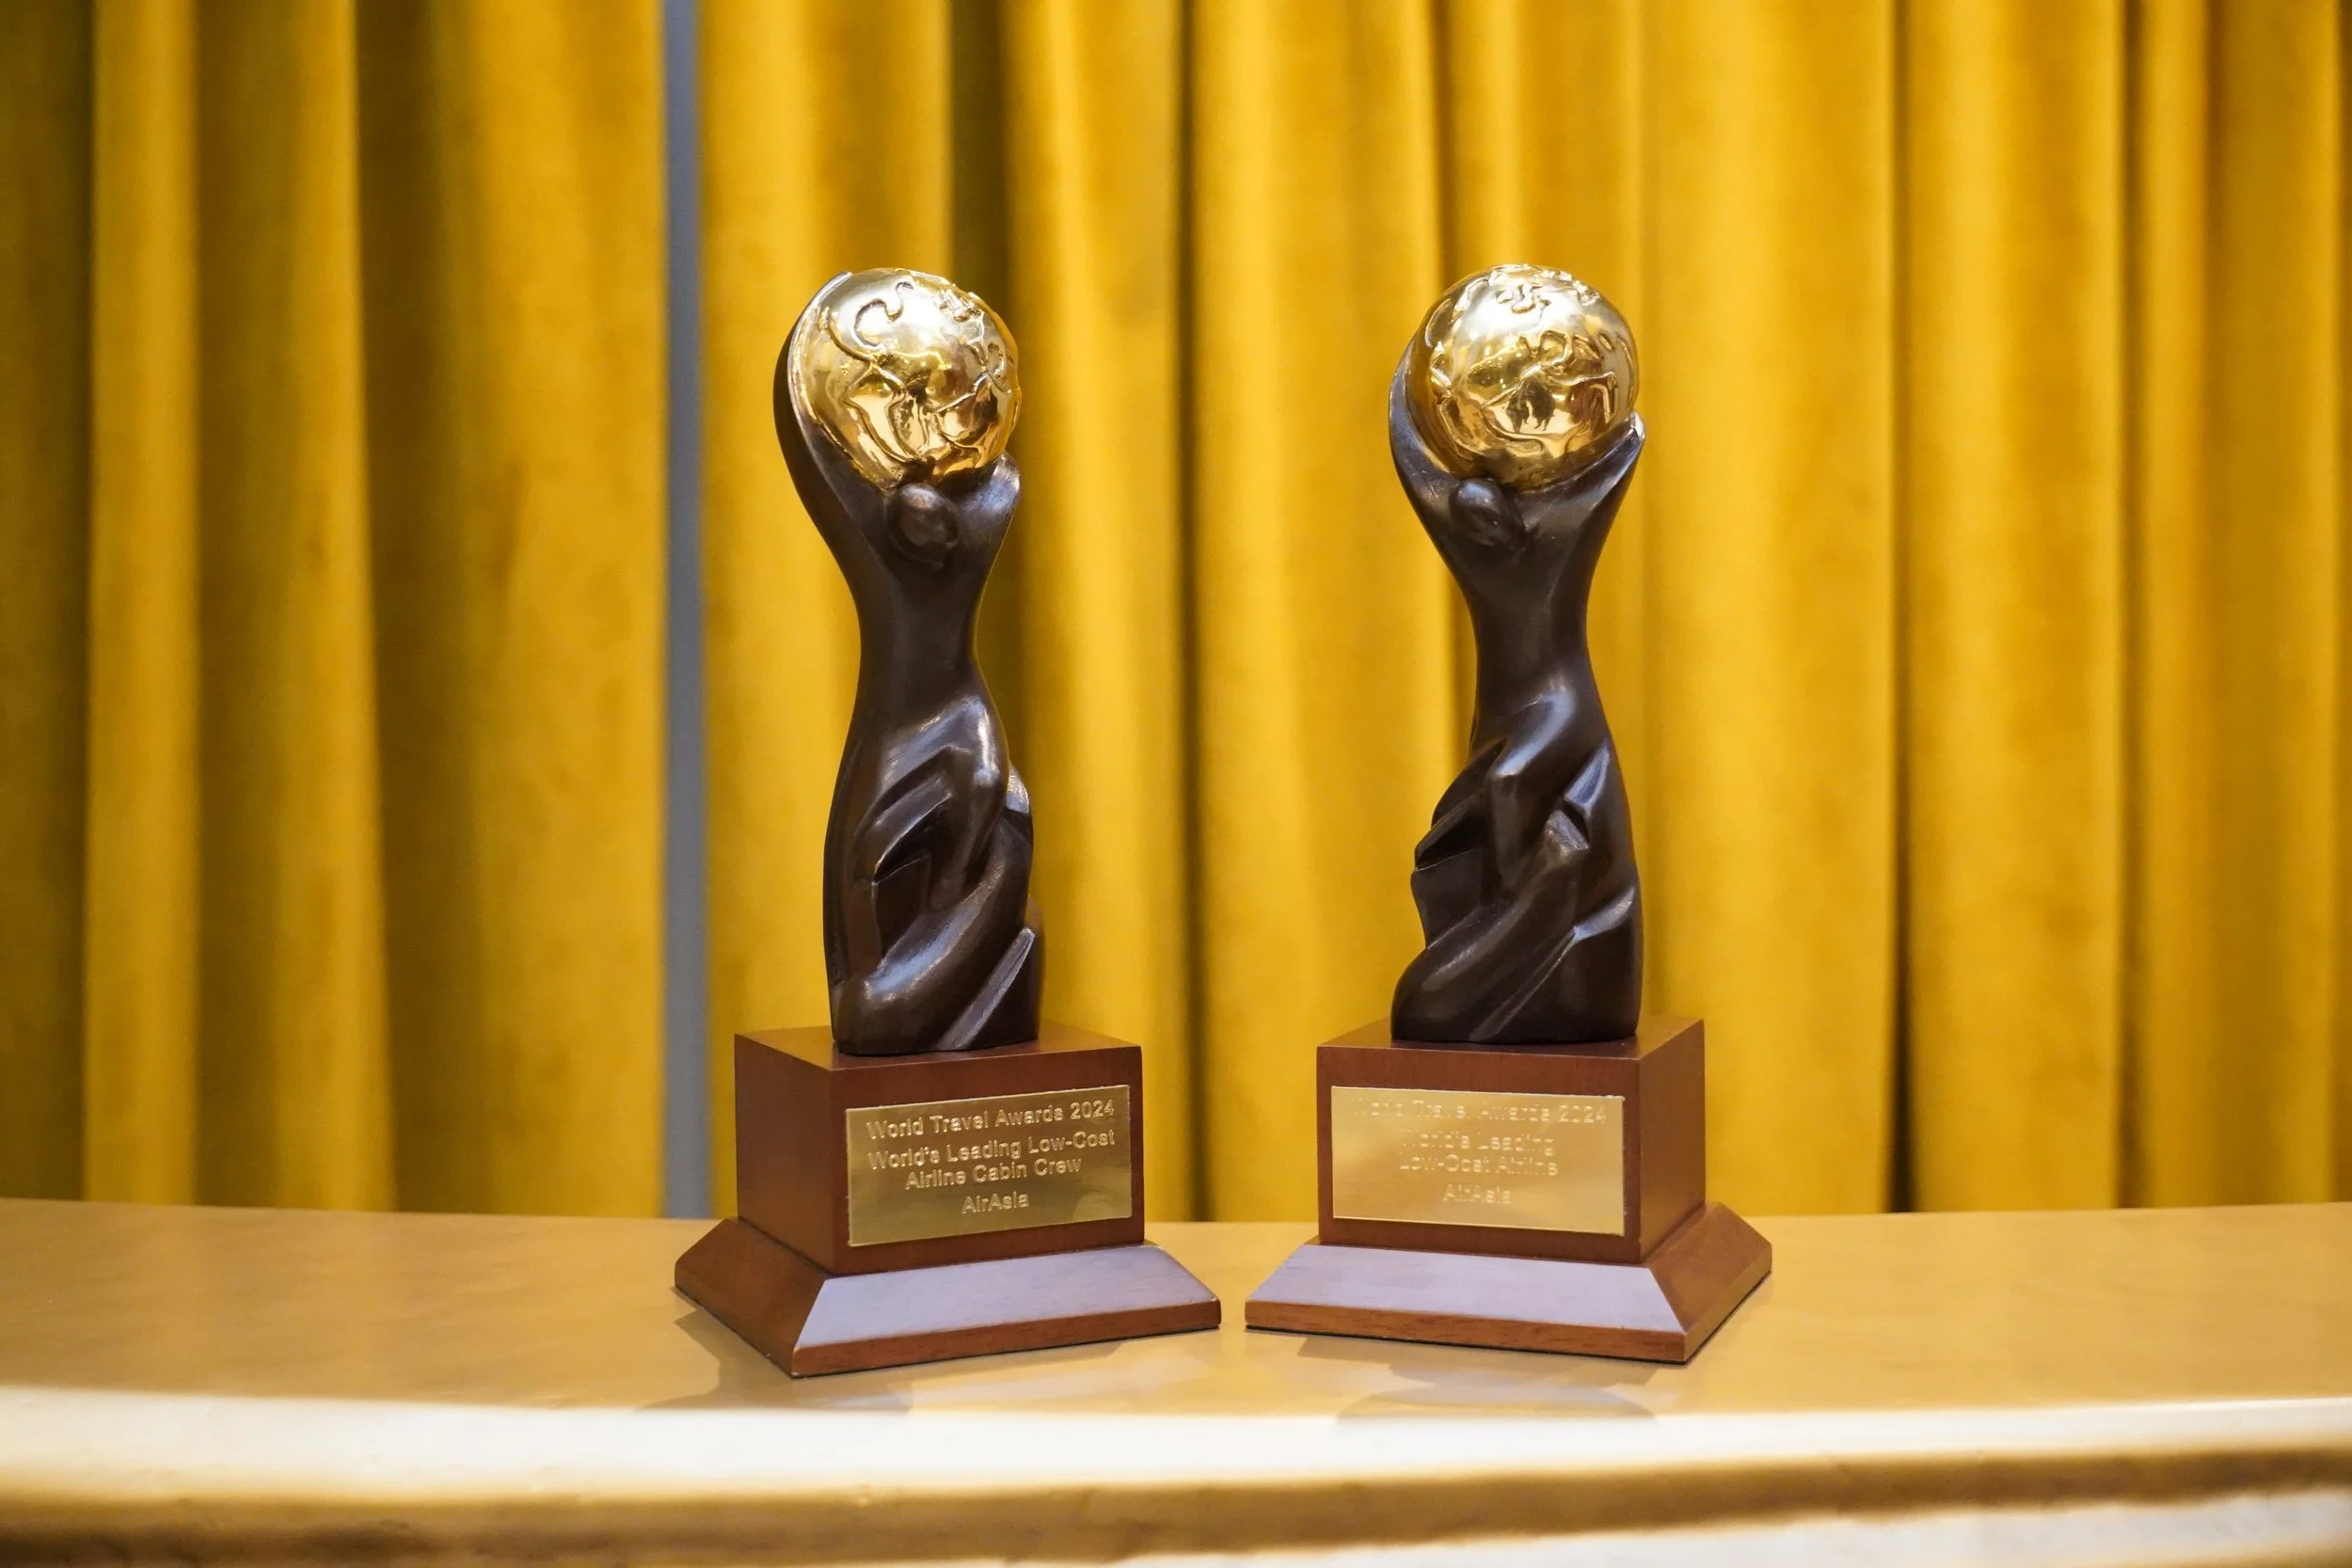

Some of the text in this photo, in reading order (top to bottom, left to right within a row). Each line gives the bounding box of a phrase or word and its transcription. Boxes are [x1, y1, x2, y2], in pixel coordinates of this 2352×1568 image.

[866, 1099, 1115, 1140] World Travel Awards 2024
[868, 1129, 1116, 1170] World's Leading Low-Cost
[905, 1157, 1082, 1191] Airline Cabin Crew
[961, 1191, 1029, 1214] AirAsia
